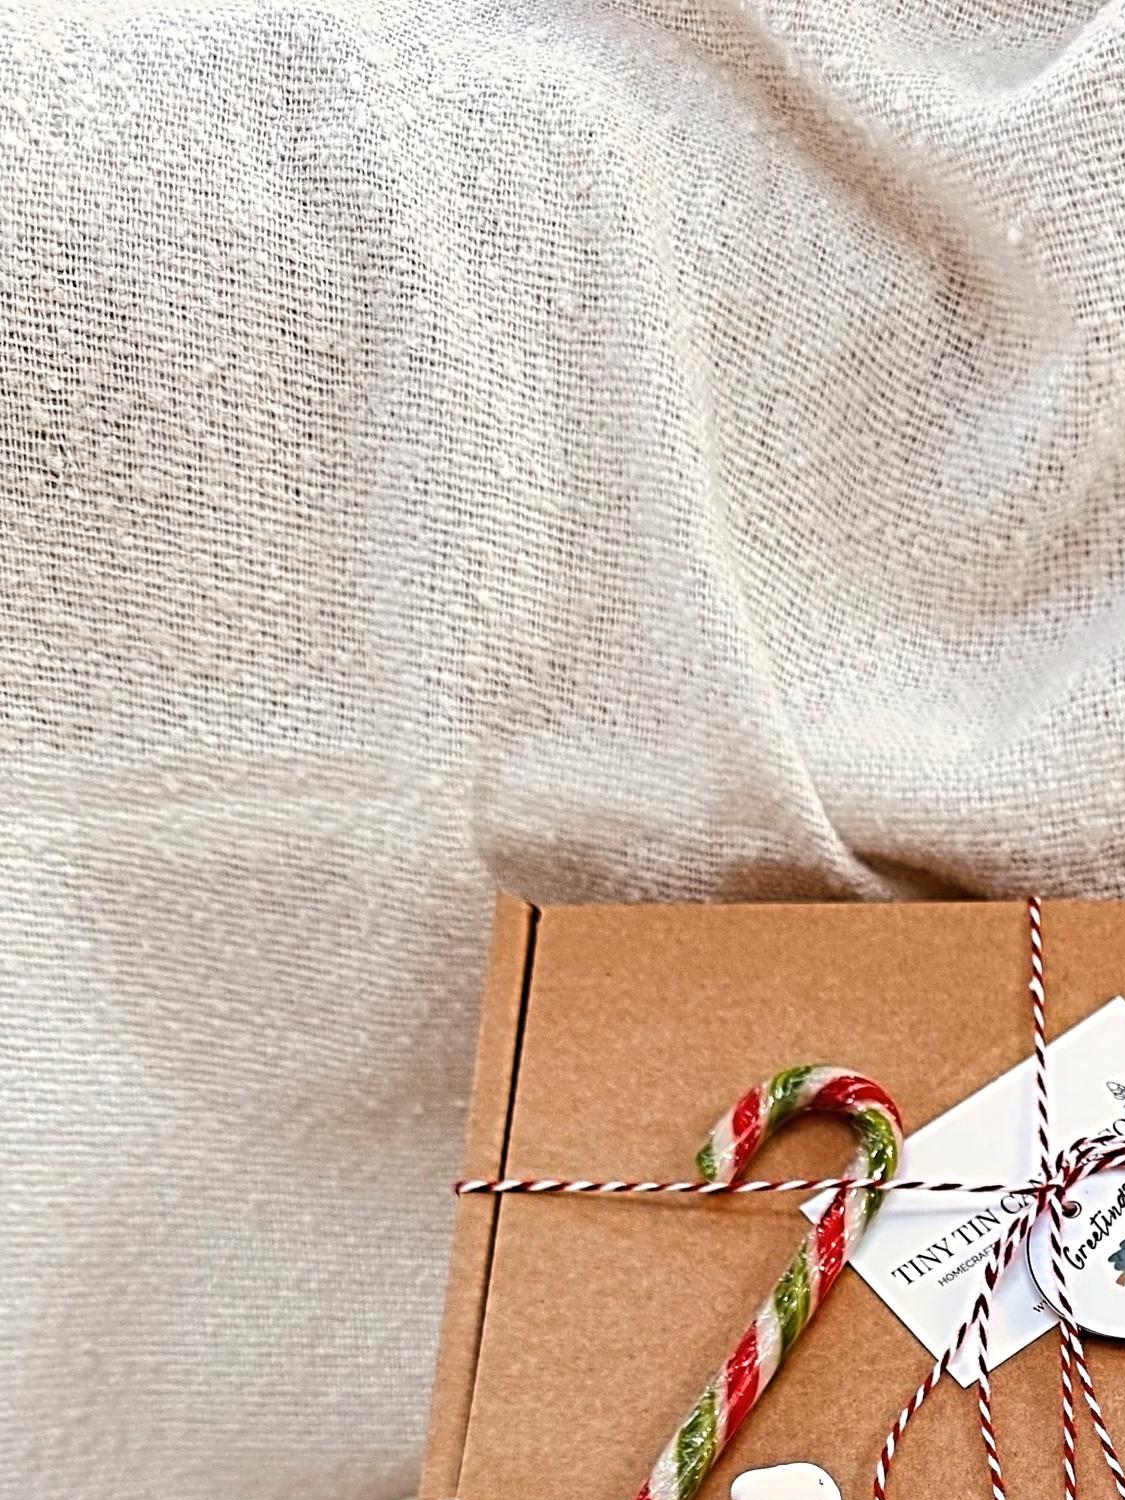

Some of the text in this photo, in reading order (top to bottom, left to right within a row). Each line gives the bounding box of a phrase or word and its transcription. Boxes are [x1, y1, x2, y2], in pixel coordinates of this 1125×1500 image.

[891, 1238, 955, 1285] TINY
[951, 1208, 1001, 1246] TIN
[938, 1244, 994, 1287] HOMECRAF
